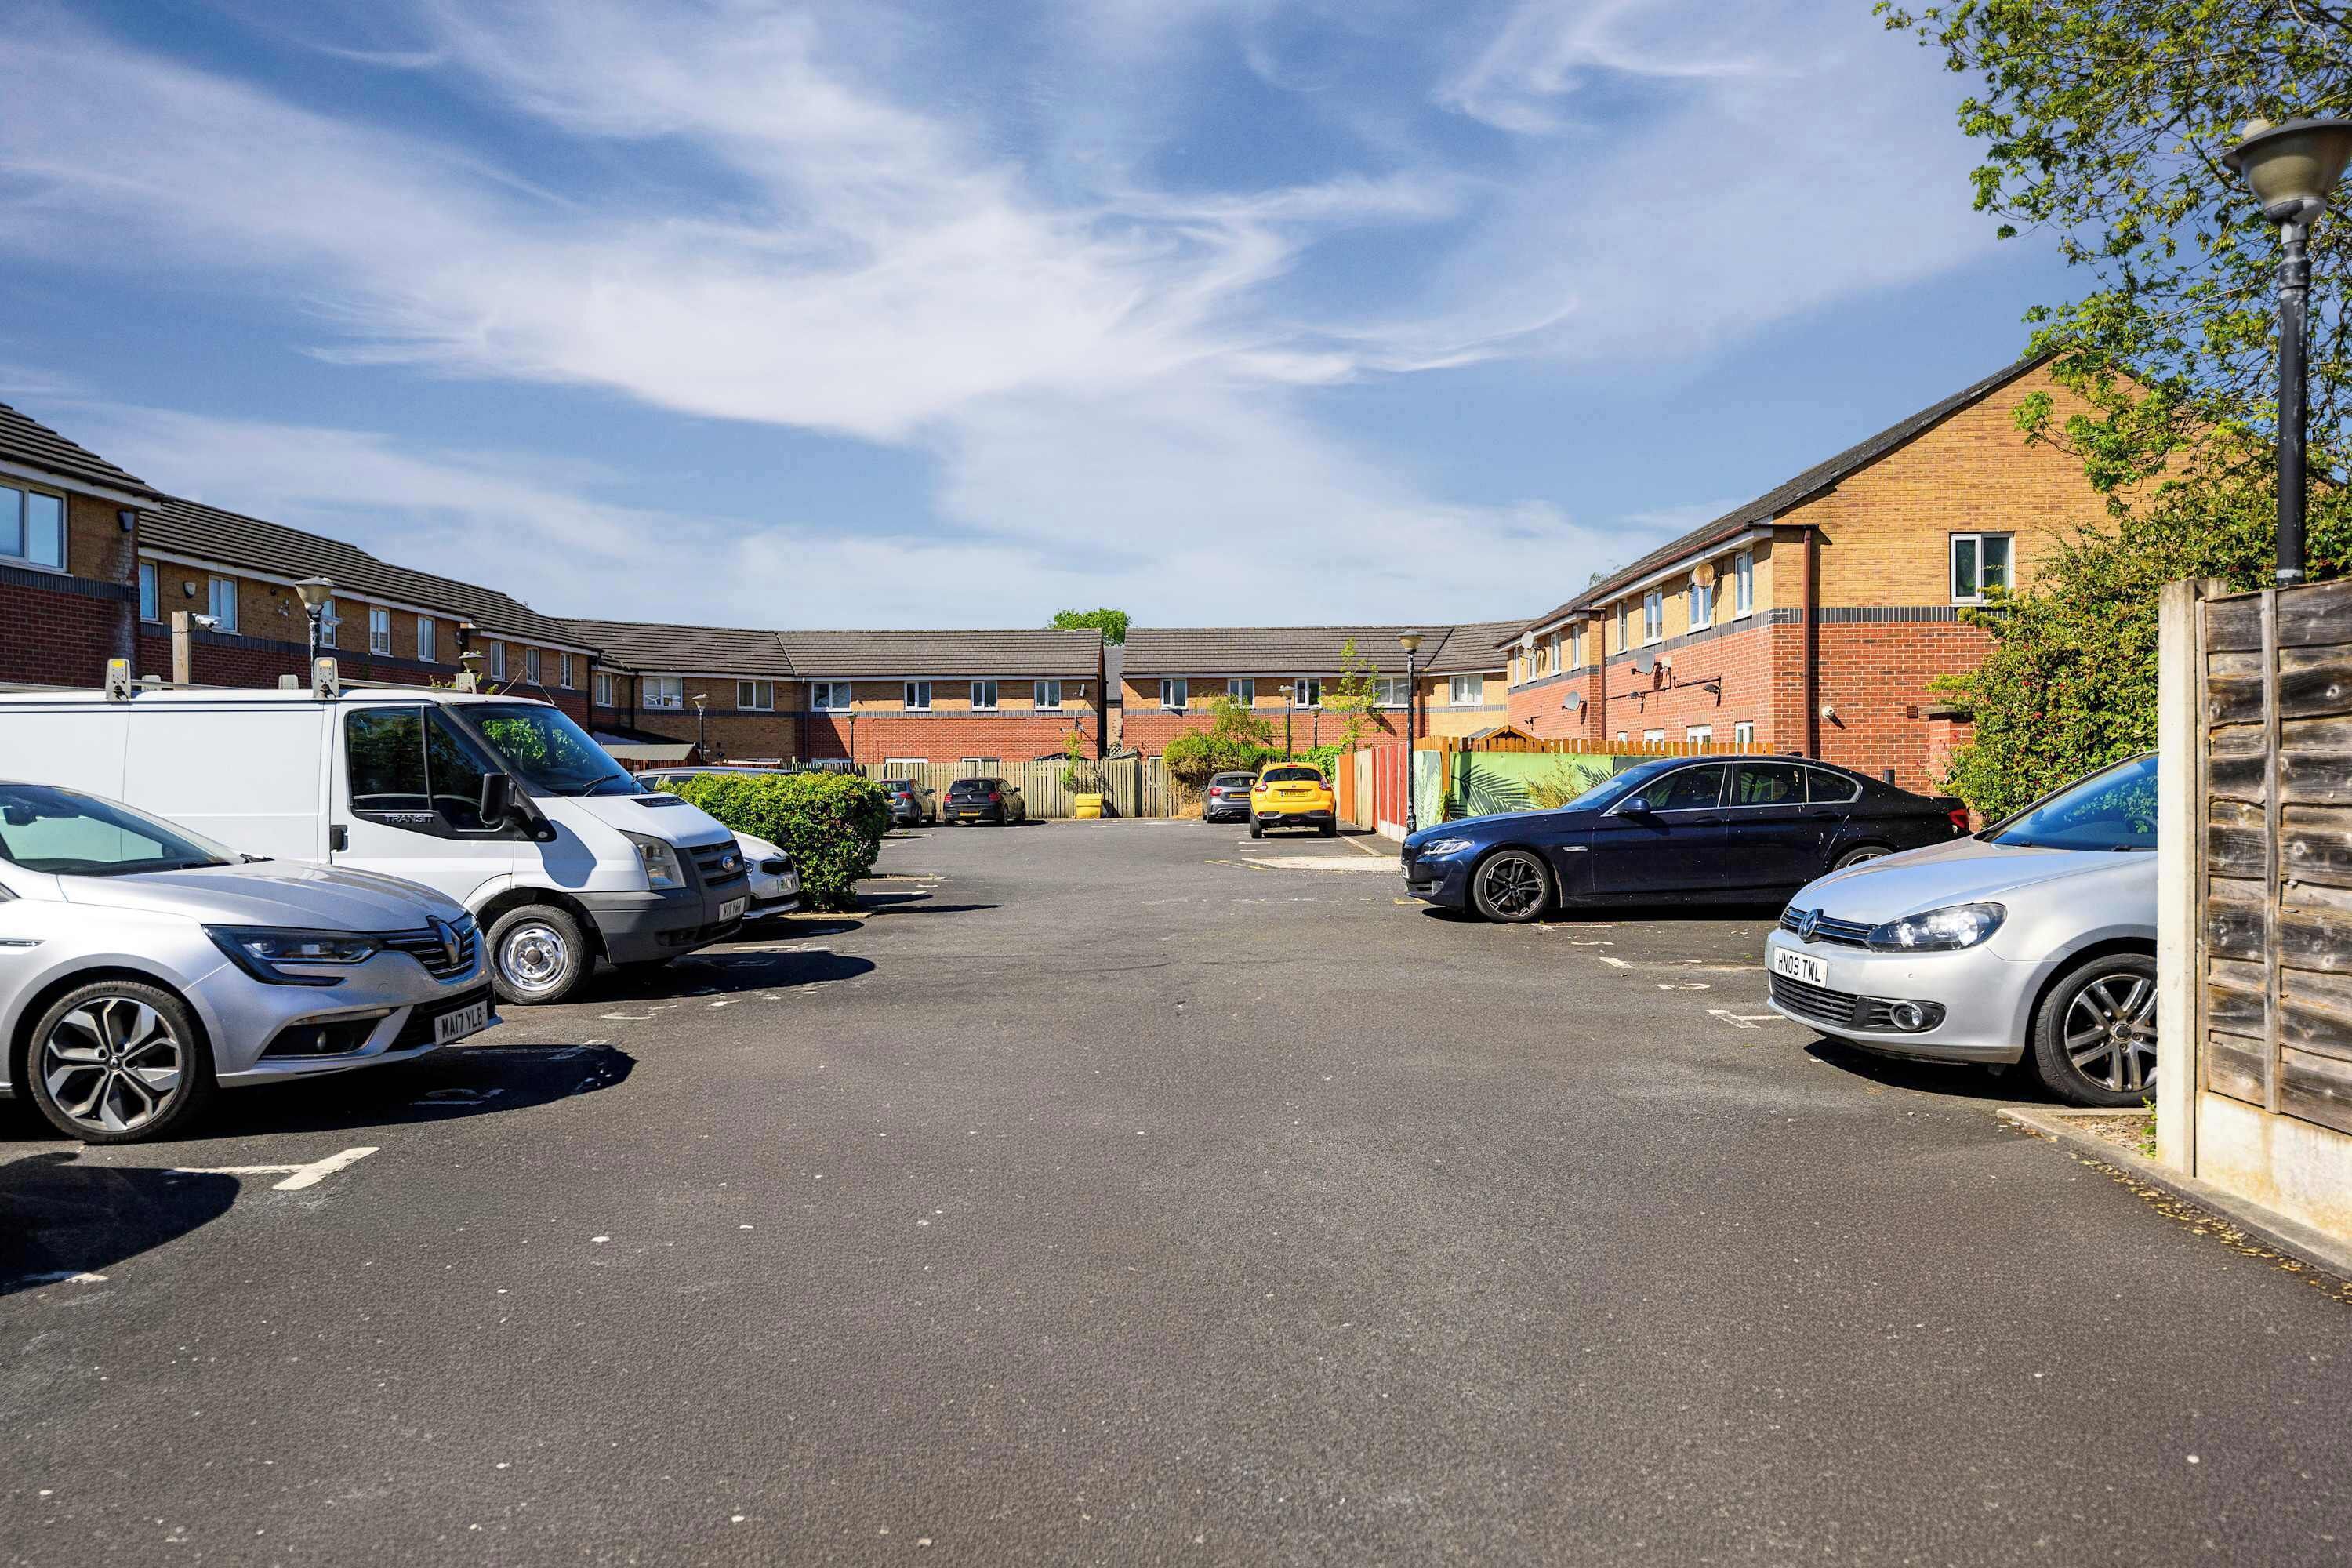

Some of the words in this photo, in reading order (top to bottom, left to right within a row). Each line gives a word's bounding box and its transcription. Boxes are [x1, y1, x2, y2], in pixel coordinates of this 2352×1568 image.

[1778, 951, 1799, 976] HN09
[1802, 959, 1821, 983] TWL
[441, 1013, 463, 1039] MA17
[466, 1007, 483, 1029] YLB
